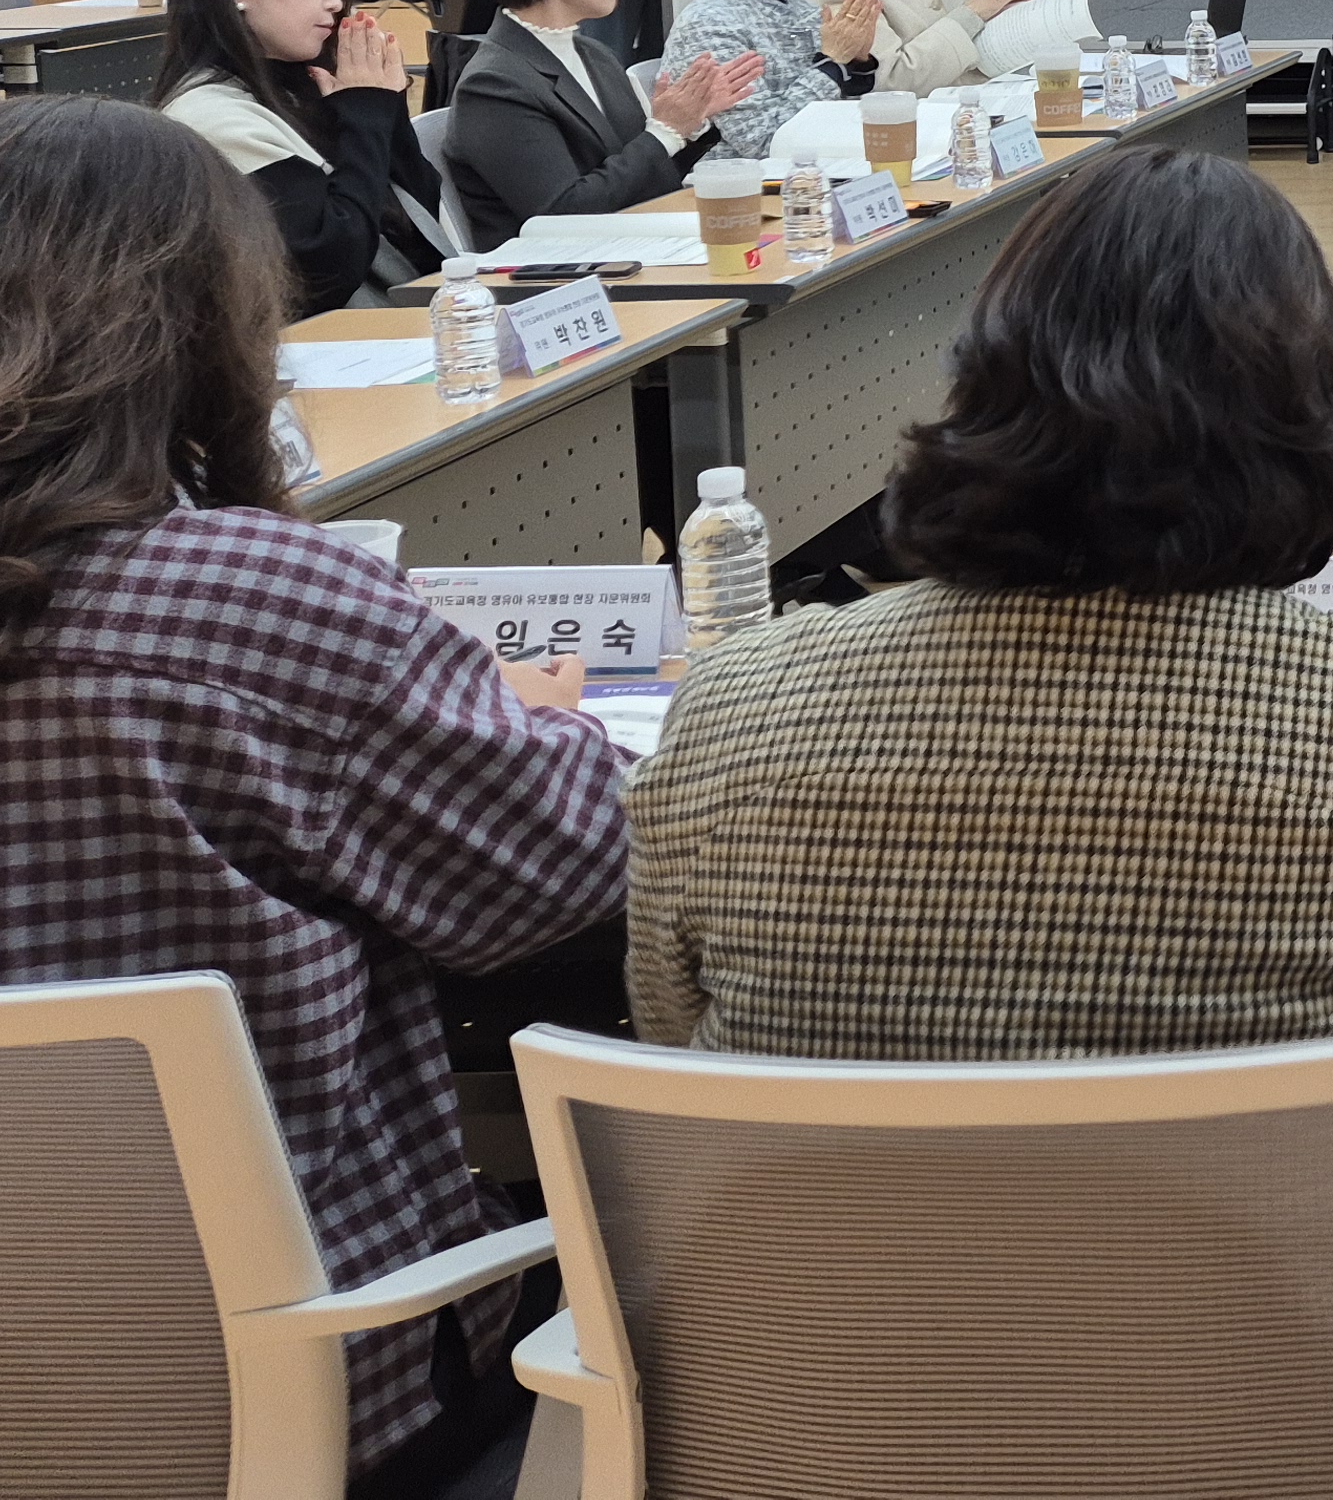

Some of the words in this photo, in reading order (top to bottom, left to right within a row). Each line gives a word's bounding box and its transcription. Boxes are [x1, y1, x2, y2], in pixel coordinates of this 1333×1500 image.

[491, 594, 522, 606] 영유아
[527, 593, 569, 606] 유보통합
[573, 593, 594, 605] 현장
